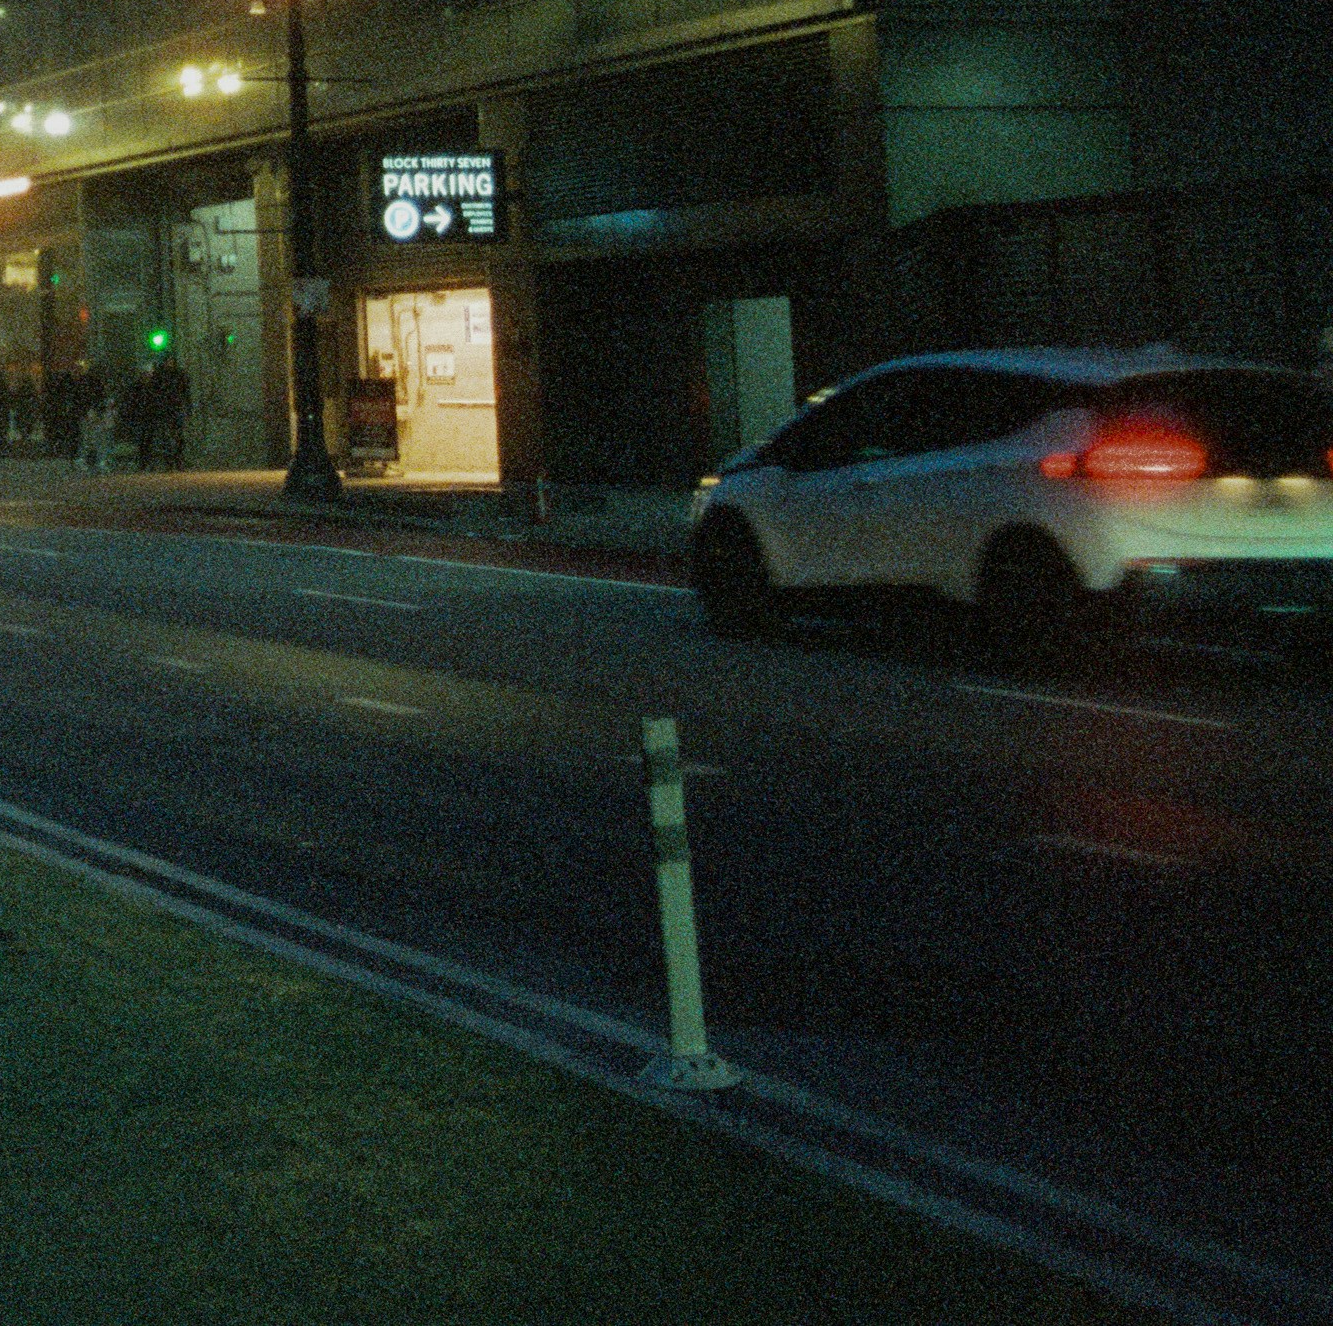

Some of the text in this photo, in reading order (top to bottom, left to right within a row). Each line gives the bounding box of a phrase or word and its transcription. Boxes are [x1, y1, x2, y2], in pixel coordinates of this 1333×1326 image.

[383, 157, 491, 168] BLOCK THIRTY SEVEN
[384, 173, 493, 196] PARKING
